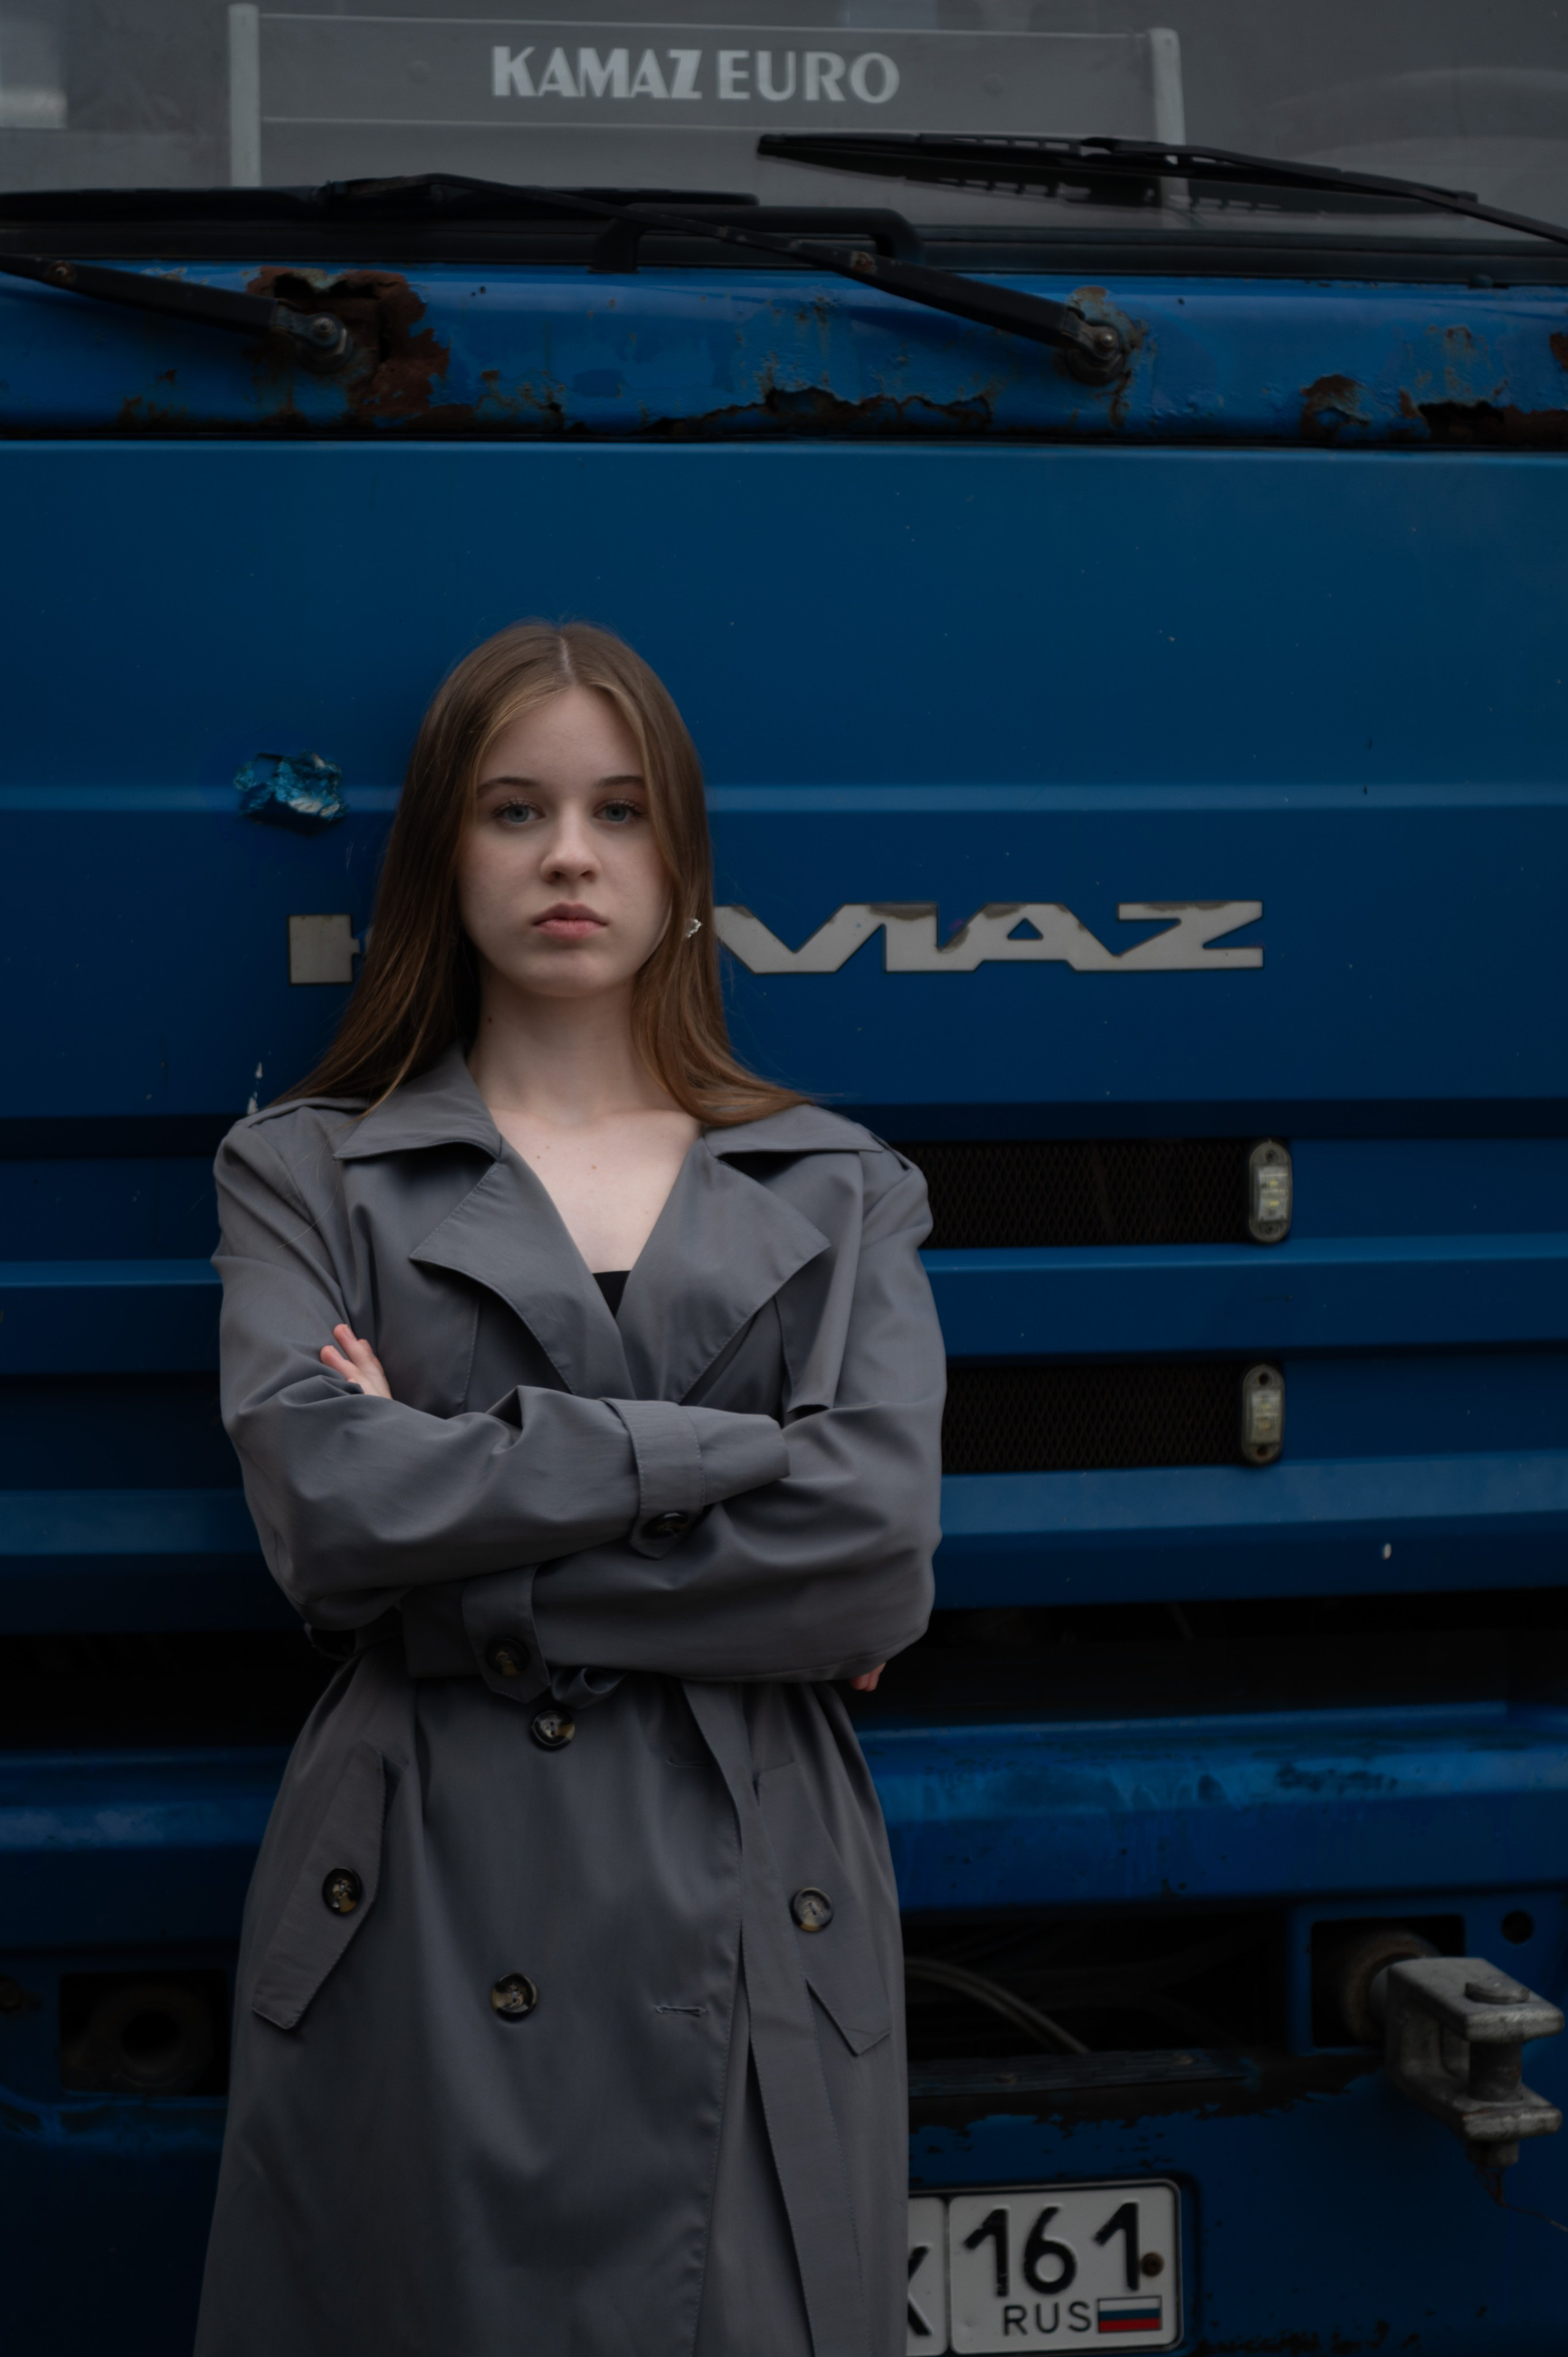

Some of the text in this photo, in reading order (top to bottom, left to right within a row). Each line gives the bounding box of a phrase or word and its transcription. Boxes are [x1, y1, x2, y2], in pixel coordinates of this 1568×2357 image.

[492, 45, 900, 104] KAMAZ EURO
[288, 900, 1264, 984] MAZ
[963, 2202, 1140, 2296] 161
[1003, 2301, 1091, 2336] RUS
